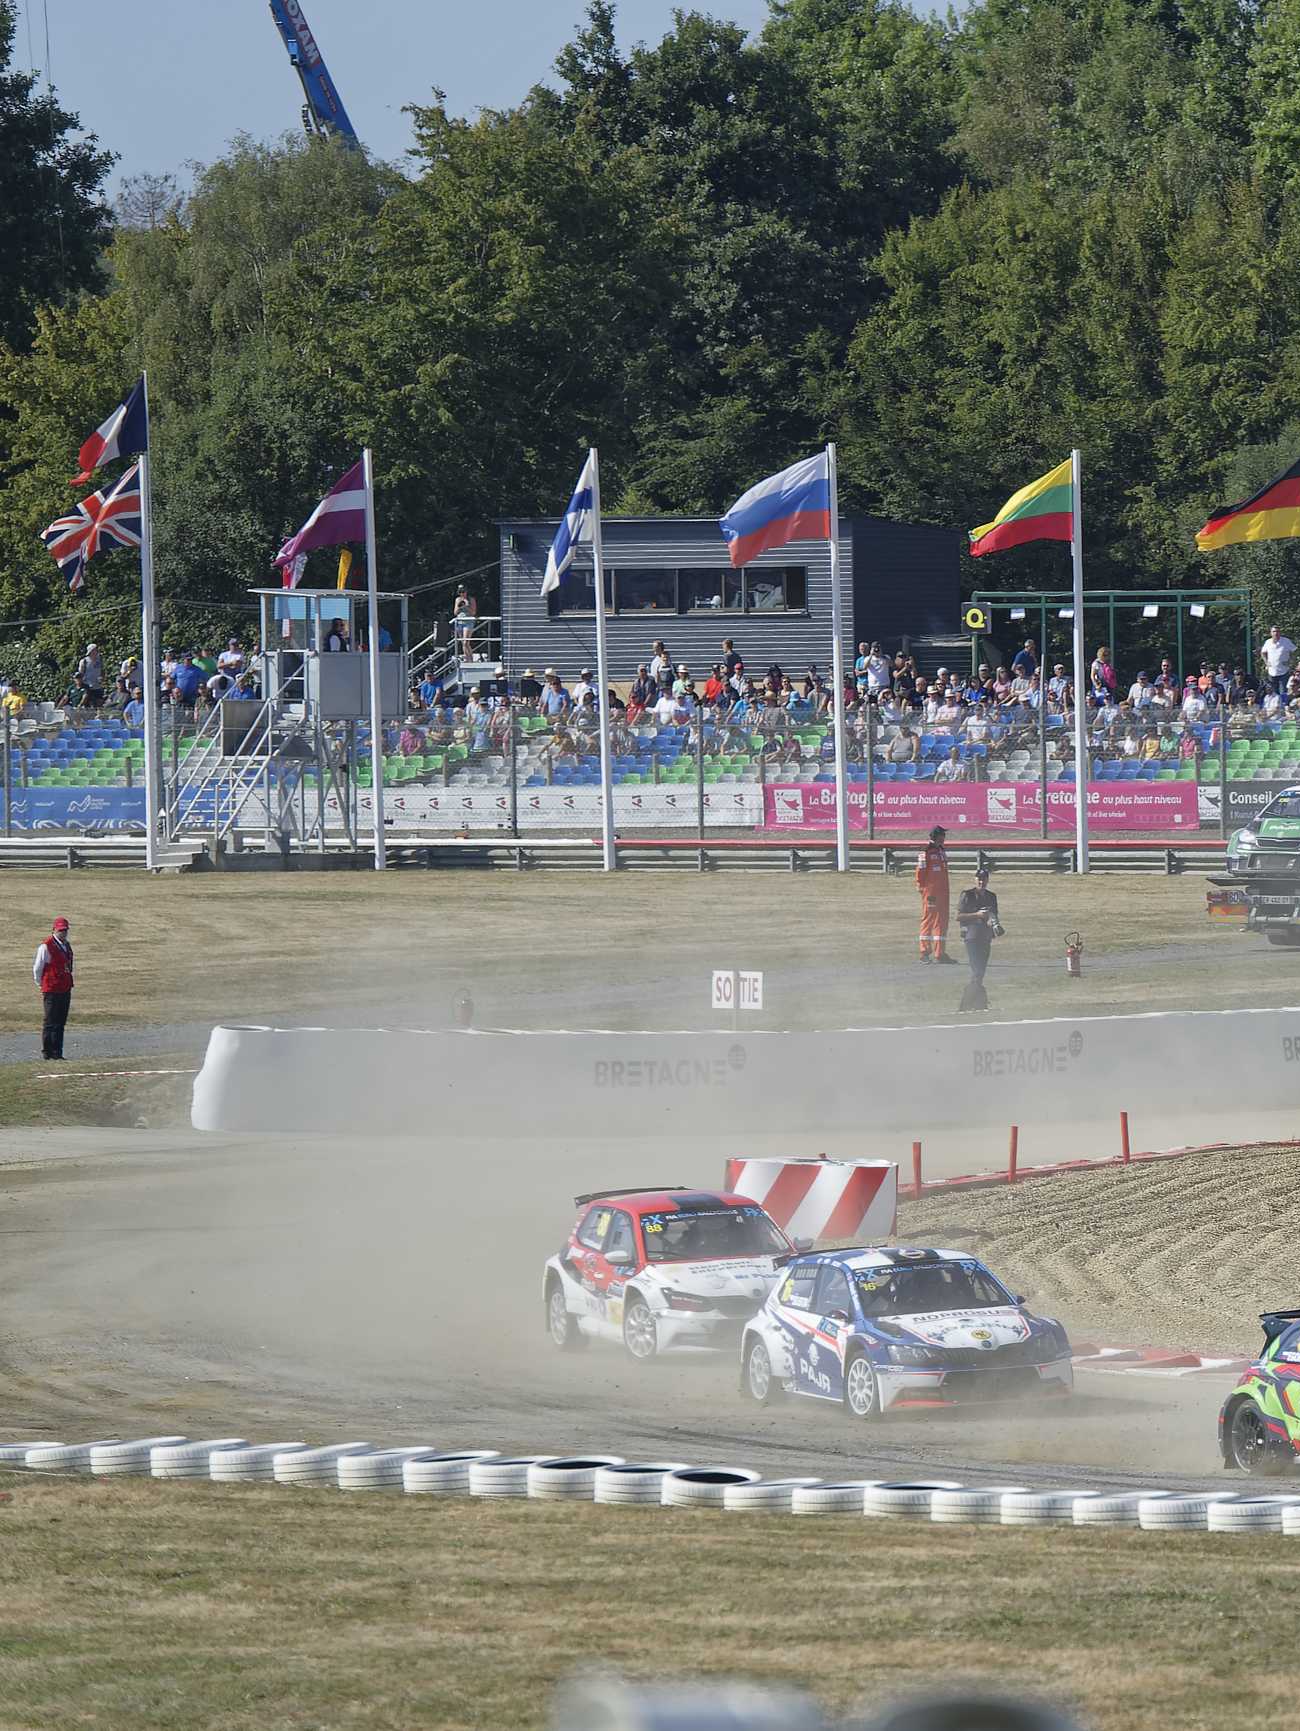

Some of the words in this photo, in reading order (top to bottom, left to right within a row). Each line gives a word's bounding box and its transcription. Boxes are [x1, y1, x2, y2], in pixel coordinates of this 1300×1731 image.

[899, 795, 917, 806] plus
[919, 795, 938, 805] haut
[939, 796, 966, 805] niveau
[1114, 796, 1133, 807] plus
[1134, 795, 1152, 805] haut
[1154, 796, 1181, 805] niveau
[716, 976, 758, 1003] SOTIE
[594, 1059, 727, 1087] BRETAGNE
[973, 1046, 1067, 1077] BRETAGNE
[800, 1358, 831, 1393] PAJR
